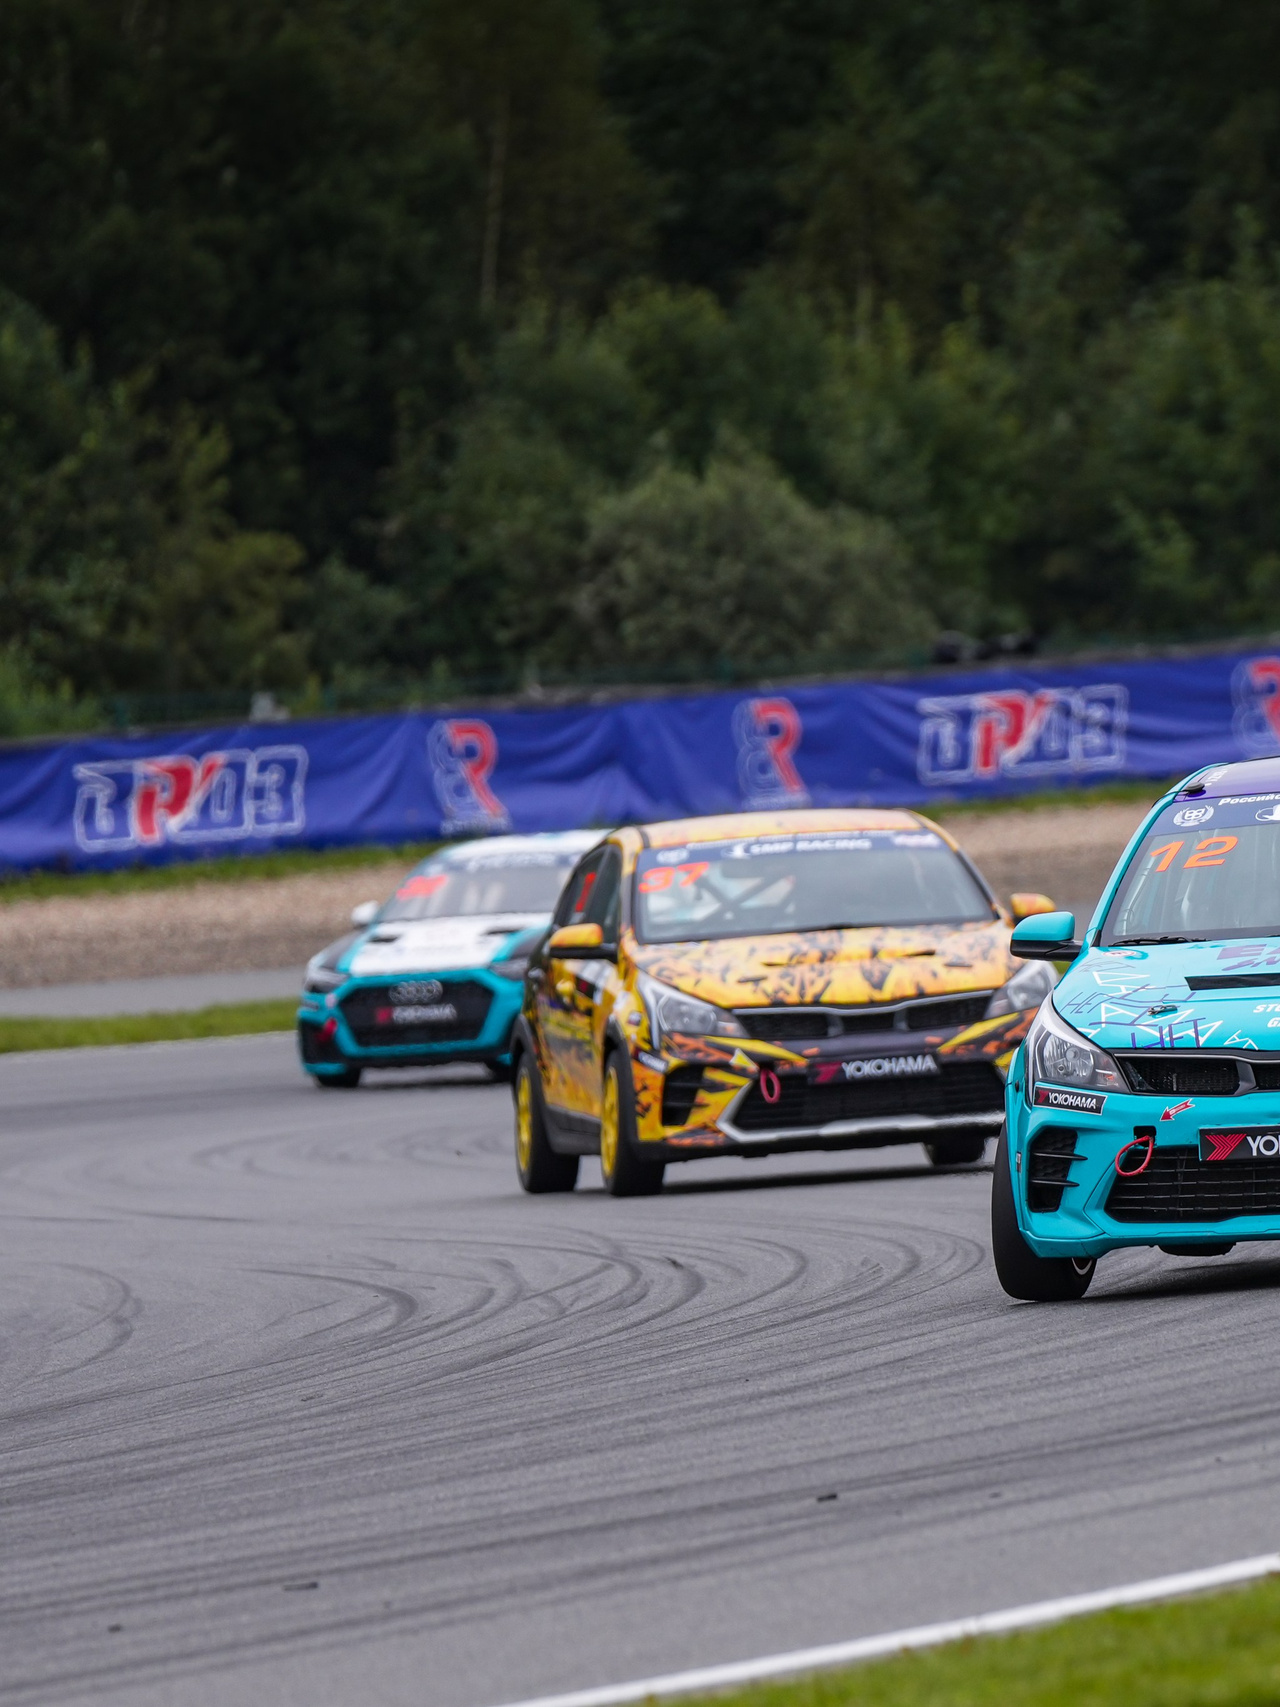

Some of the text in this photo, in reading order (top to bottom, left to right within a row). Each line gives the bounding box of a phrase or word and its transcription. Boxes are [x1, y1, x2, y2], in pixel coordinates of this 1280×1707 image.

[1150, 836, 1239, 872] 12
[639, 862, 709, 893] 37
[842, 1054, 938, 1080] YOKOHAMA
[1048, 1092, 1097, 1110] YOKOHAMA
